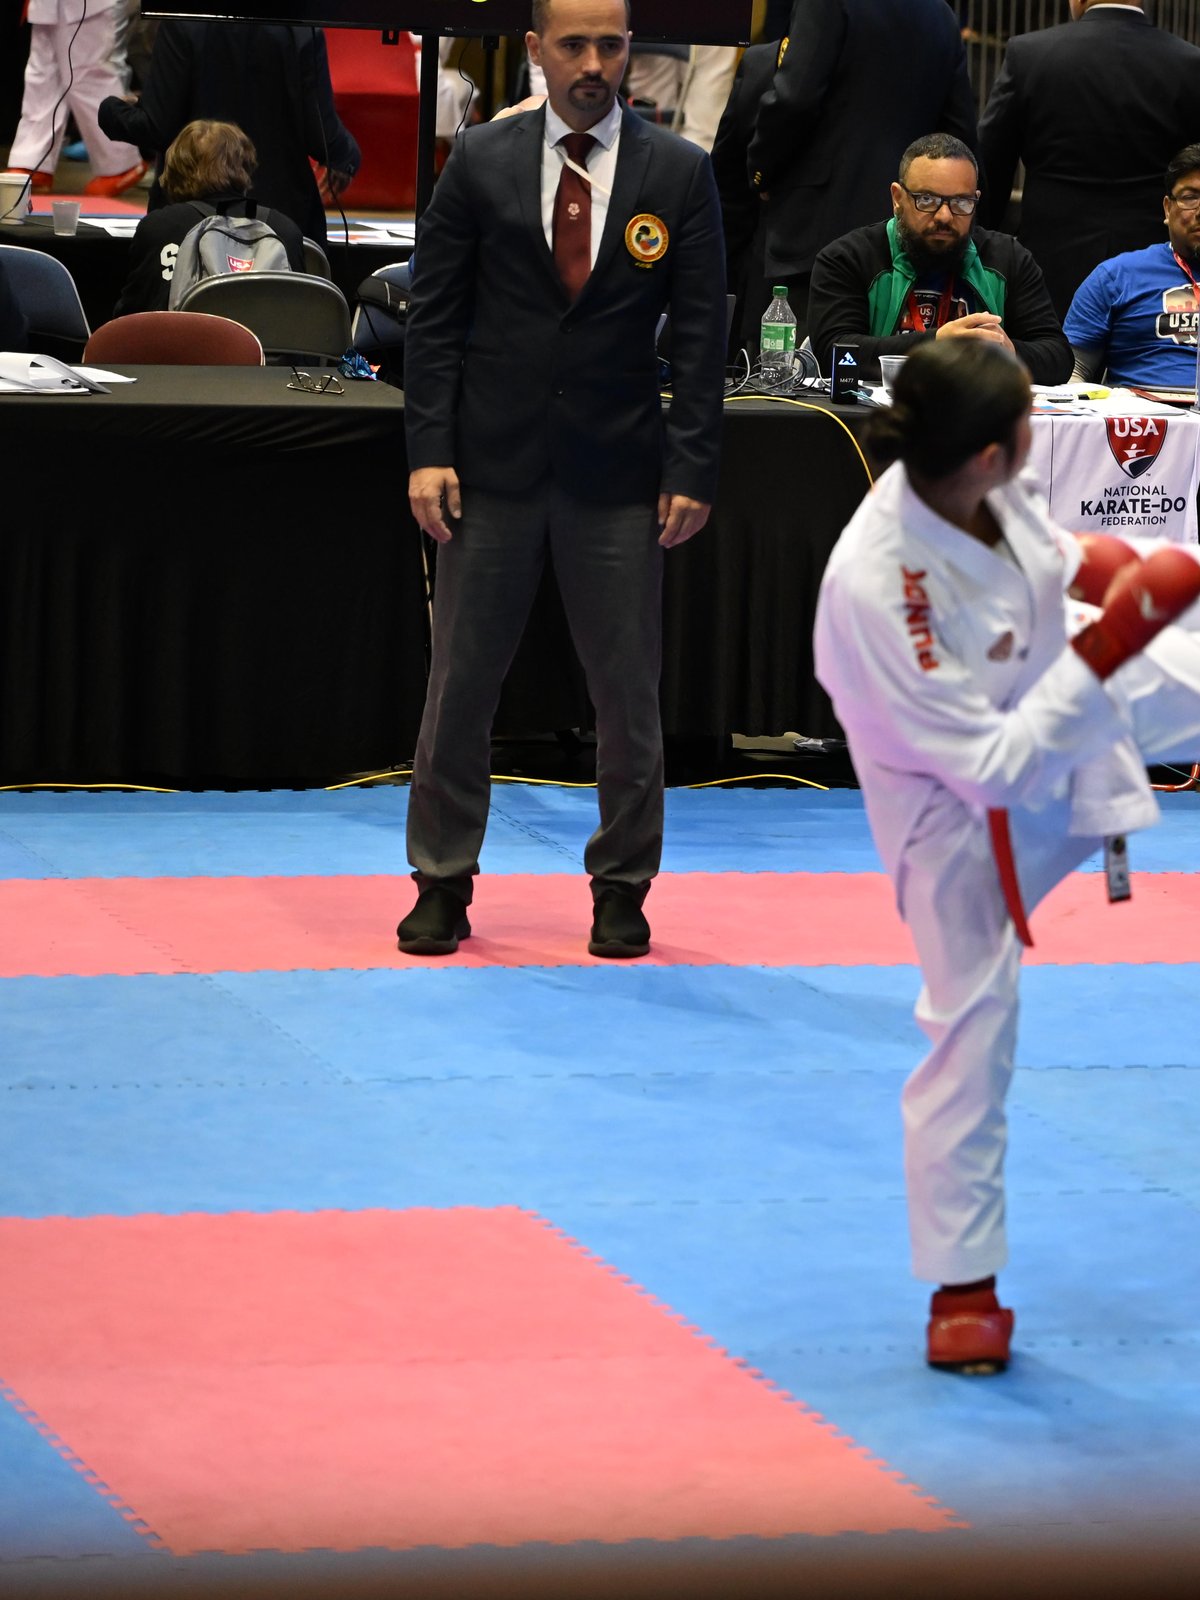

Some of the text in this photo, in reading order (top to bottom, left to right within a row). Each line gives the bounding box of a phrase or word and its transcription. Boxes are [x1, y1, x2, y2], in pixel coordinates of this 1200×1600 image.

[229, 258, 251, 269] USA
[1169, 313, 1200, 328] USA
[1114, 418, 1160, 438] USA
[1103, 485, 1167, 498] NATIONAL
[1081, 496, 1186, 517] KARATE-DO
[1101, 515, 1167, 526] FEDERATION
